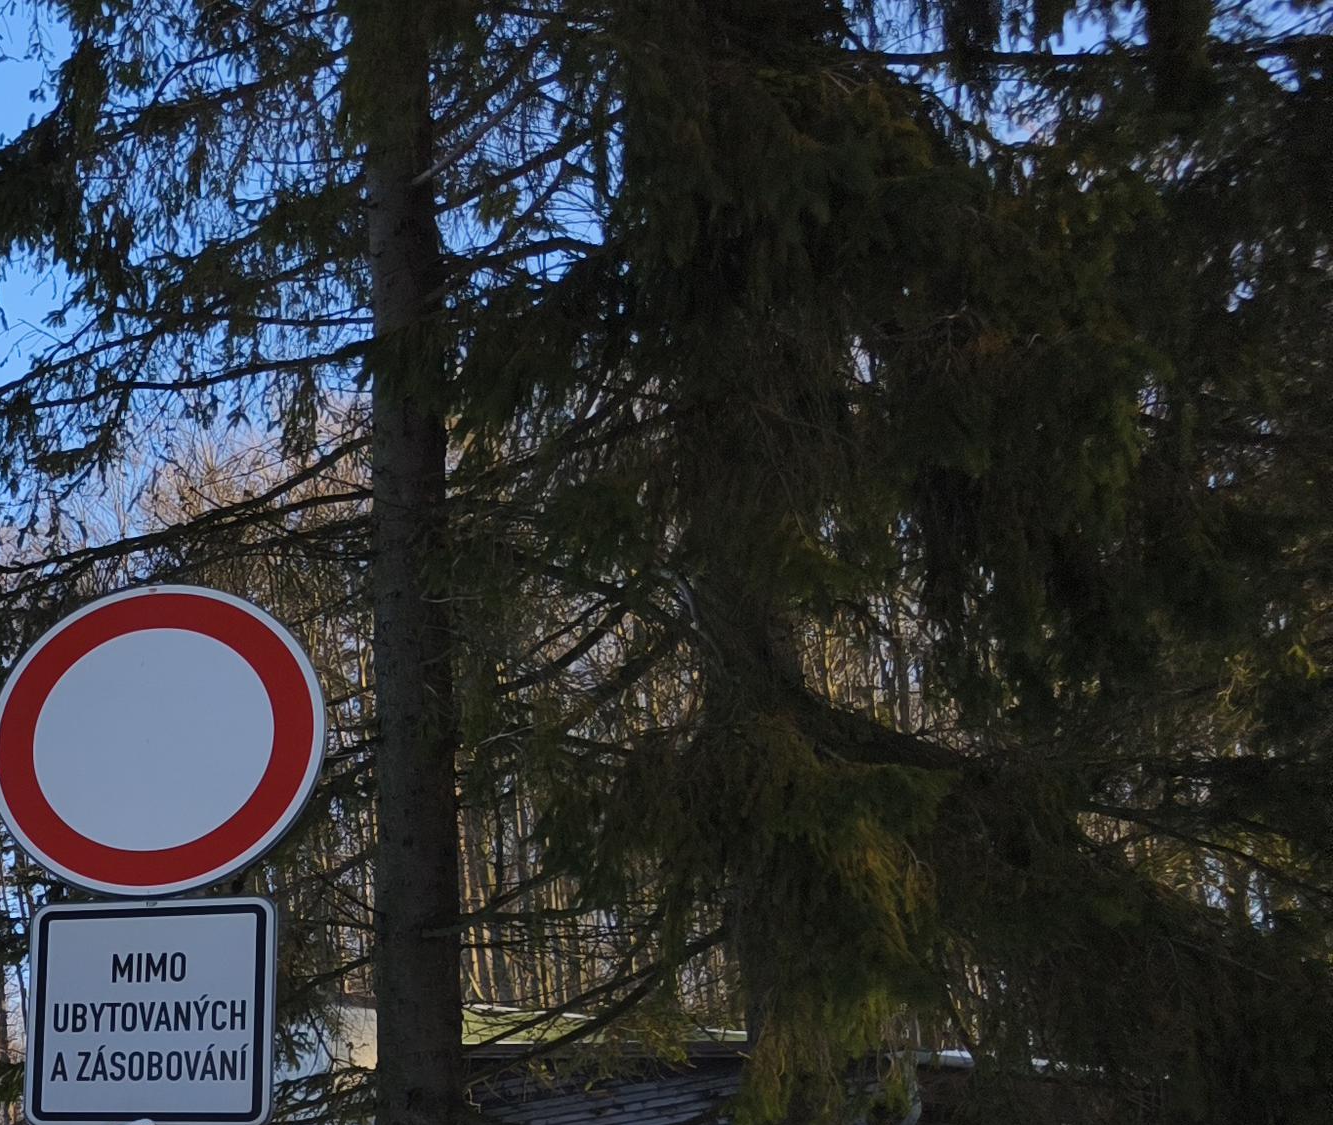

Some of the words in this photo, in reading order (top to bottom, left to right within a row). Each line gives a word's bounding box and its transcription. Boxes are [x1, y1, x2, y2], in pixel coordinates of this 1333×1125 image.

[111, 952, 186, 983] MIMO
[53, 994, 247, 1033] UBYTOVANÝCH
[50, 1052, 68, 1082] A
[76, 1044, 250, 1082] ZÁSOBOVÁNÍ
